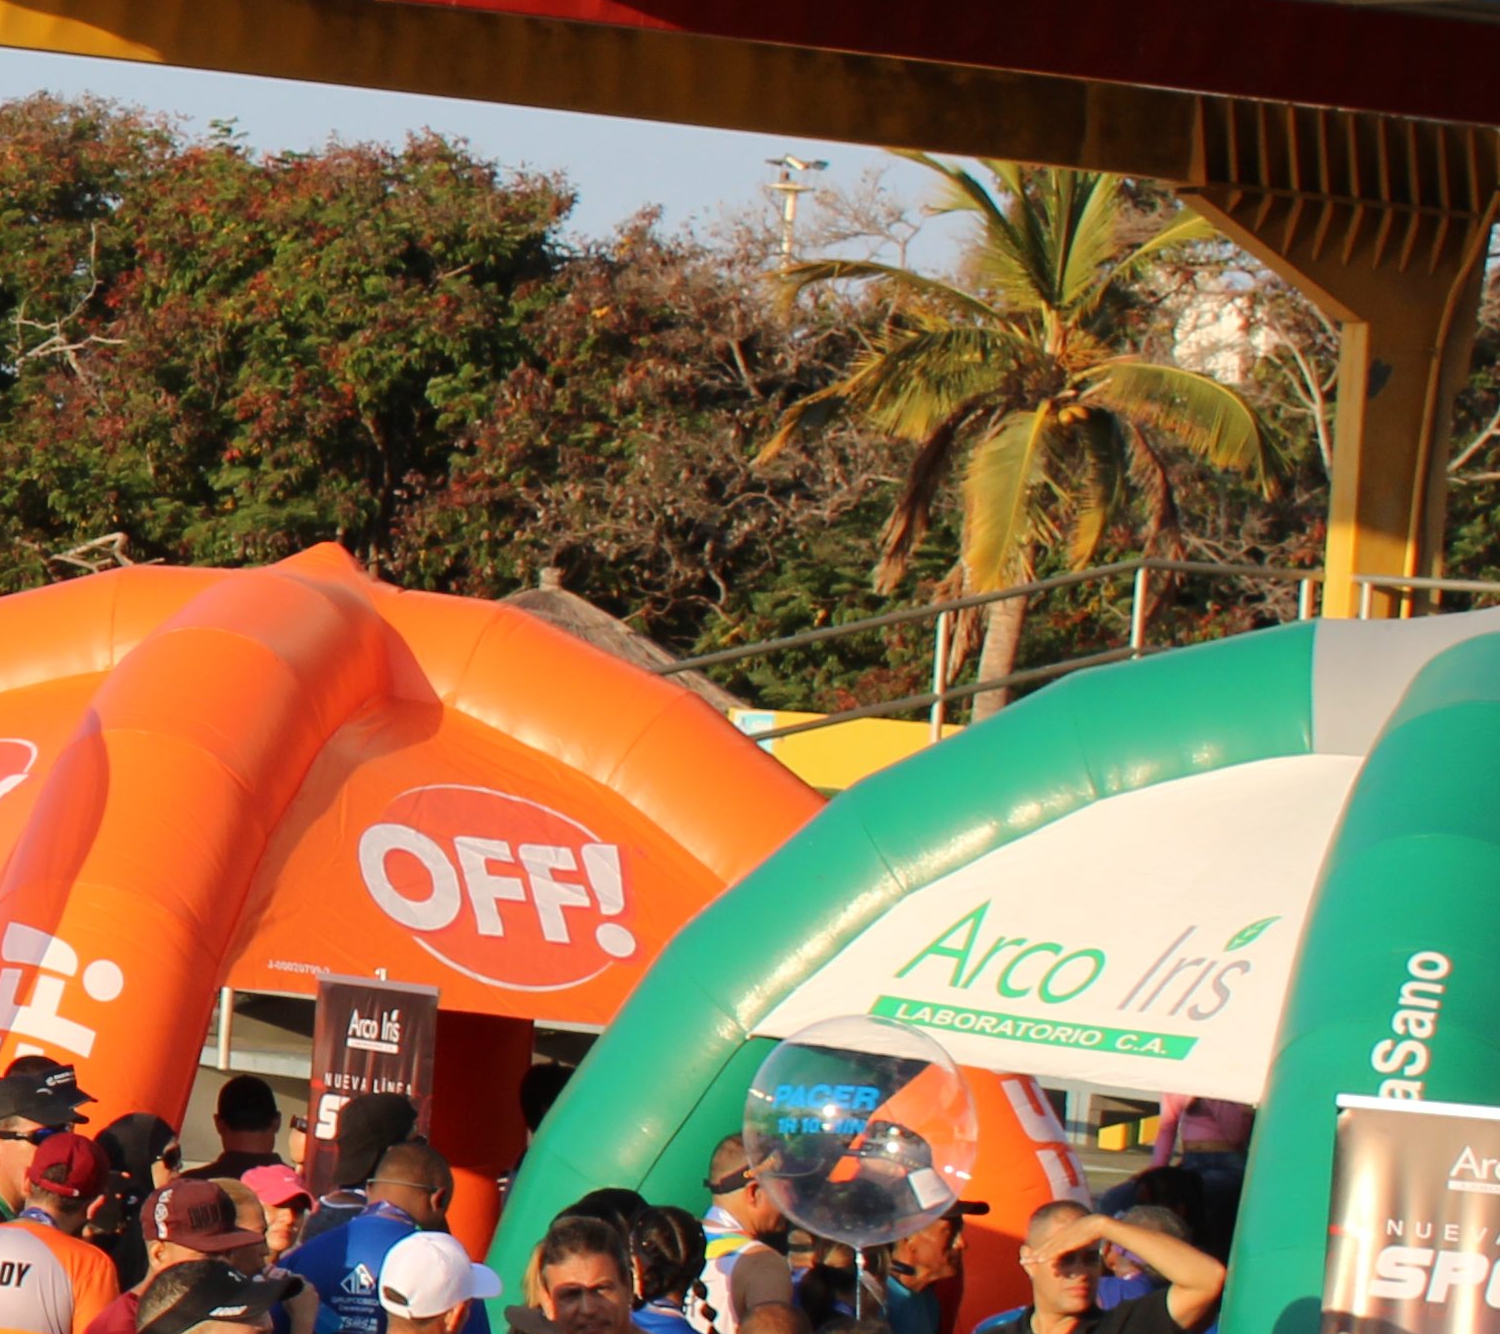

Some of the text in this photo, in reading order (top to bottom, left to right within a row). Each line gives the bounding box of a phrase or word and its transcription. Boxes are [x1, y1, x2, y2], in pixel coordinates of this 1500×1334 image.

[359, 822, 638, 958] OFF!
[893, 898, 1257, 1021] Arco Iris
[348, 1008, 401, 1043] Arco Iris
[894, 1002, 1168, 1056] LABORATORIO C.A.
[324, 1072, 367, 1092] NUEVA
[771, 1083, 880, 1111] PACER
[1368, 1244, 1500, 1310] SP
